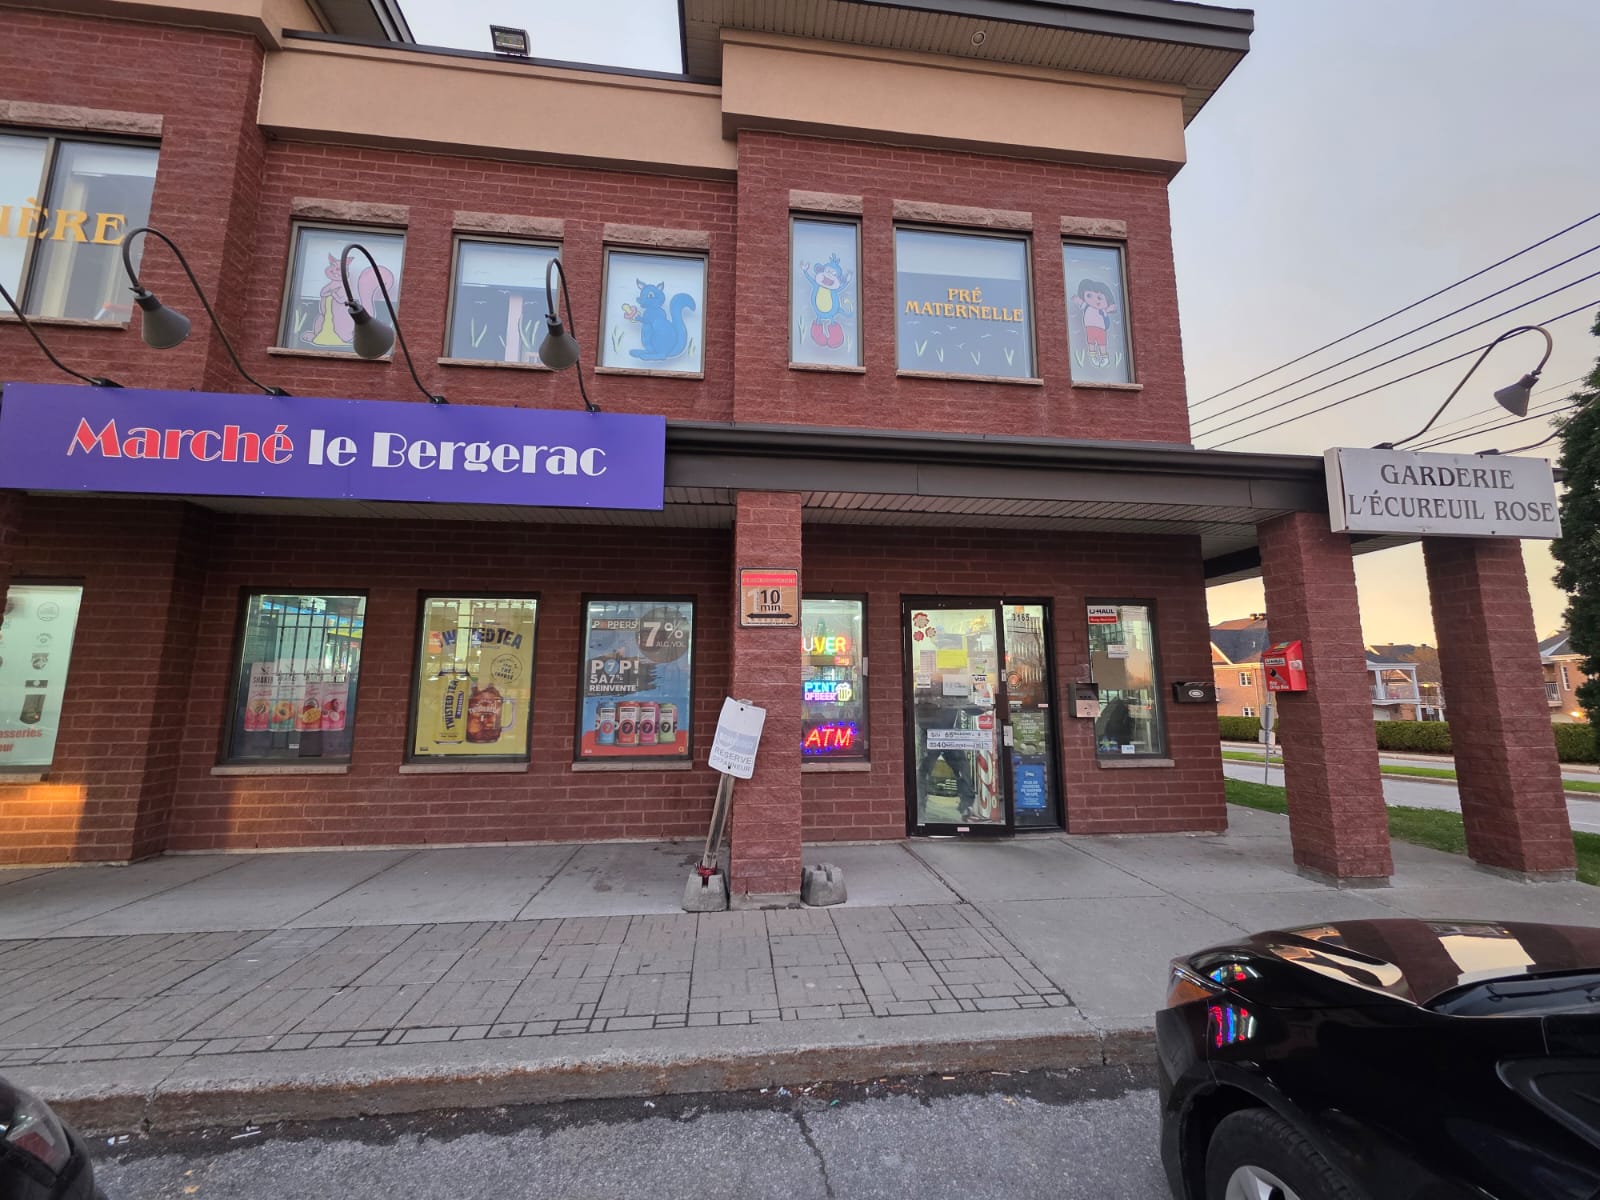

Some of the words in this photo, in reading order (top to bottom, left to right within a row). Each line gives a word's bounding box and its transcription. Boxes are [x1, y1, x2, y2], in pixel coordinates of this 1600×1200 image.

[948, 287, 982, 303] PRÉ
[905, 301, 1023, 321] MATERNELLE
[67, 417, 293, 465] Marché
[308, 429, 356, 466] le
[371, 432, 606, 477] Bergerac
[1380, 464, 1514, 489] GARDERIE
[1349, 490, 1484, 519] L'ÉCUREUIL
[1495, 501, 1555, 521] ROSE
[760, 590, 780, 604] 10
[497, 628, 523, 649] TEA
[804, 682, 837, 692] PINT
[803, 728, 853, 747] ATM
